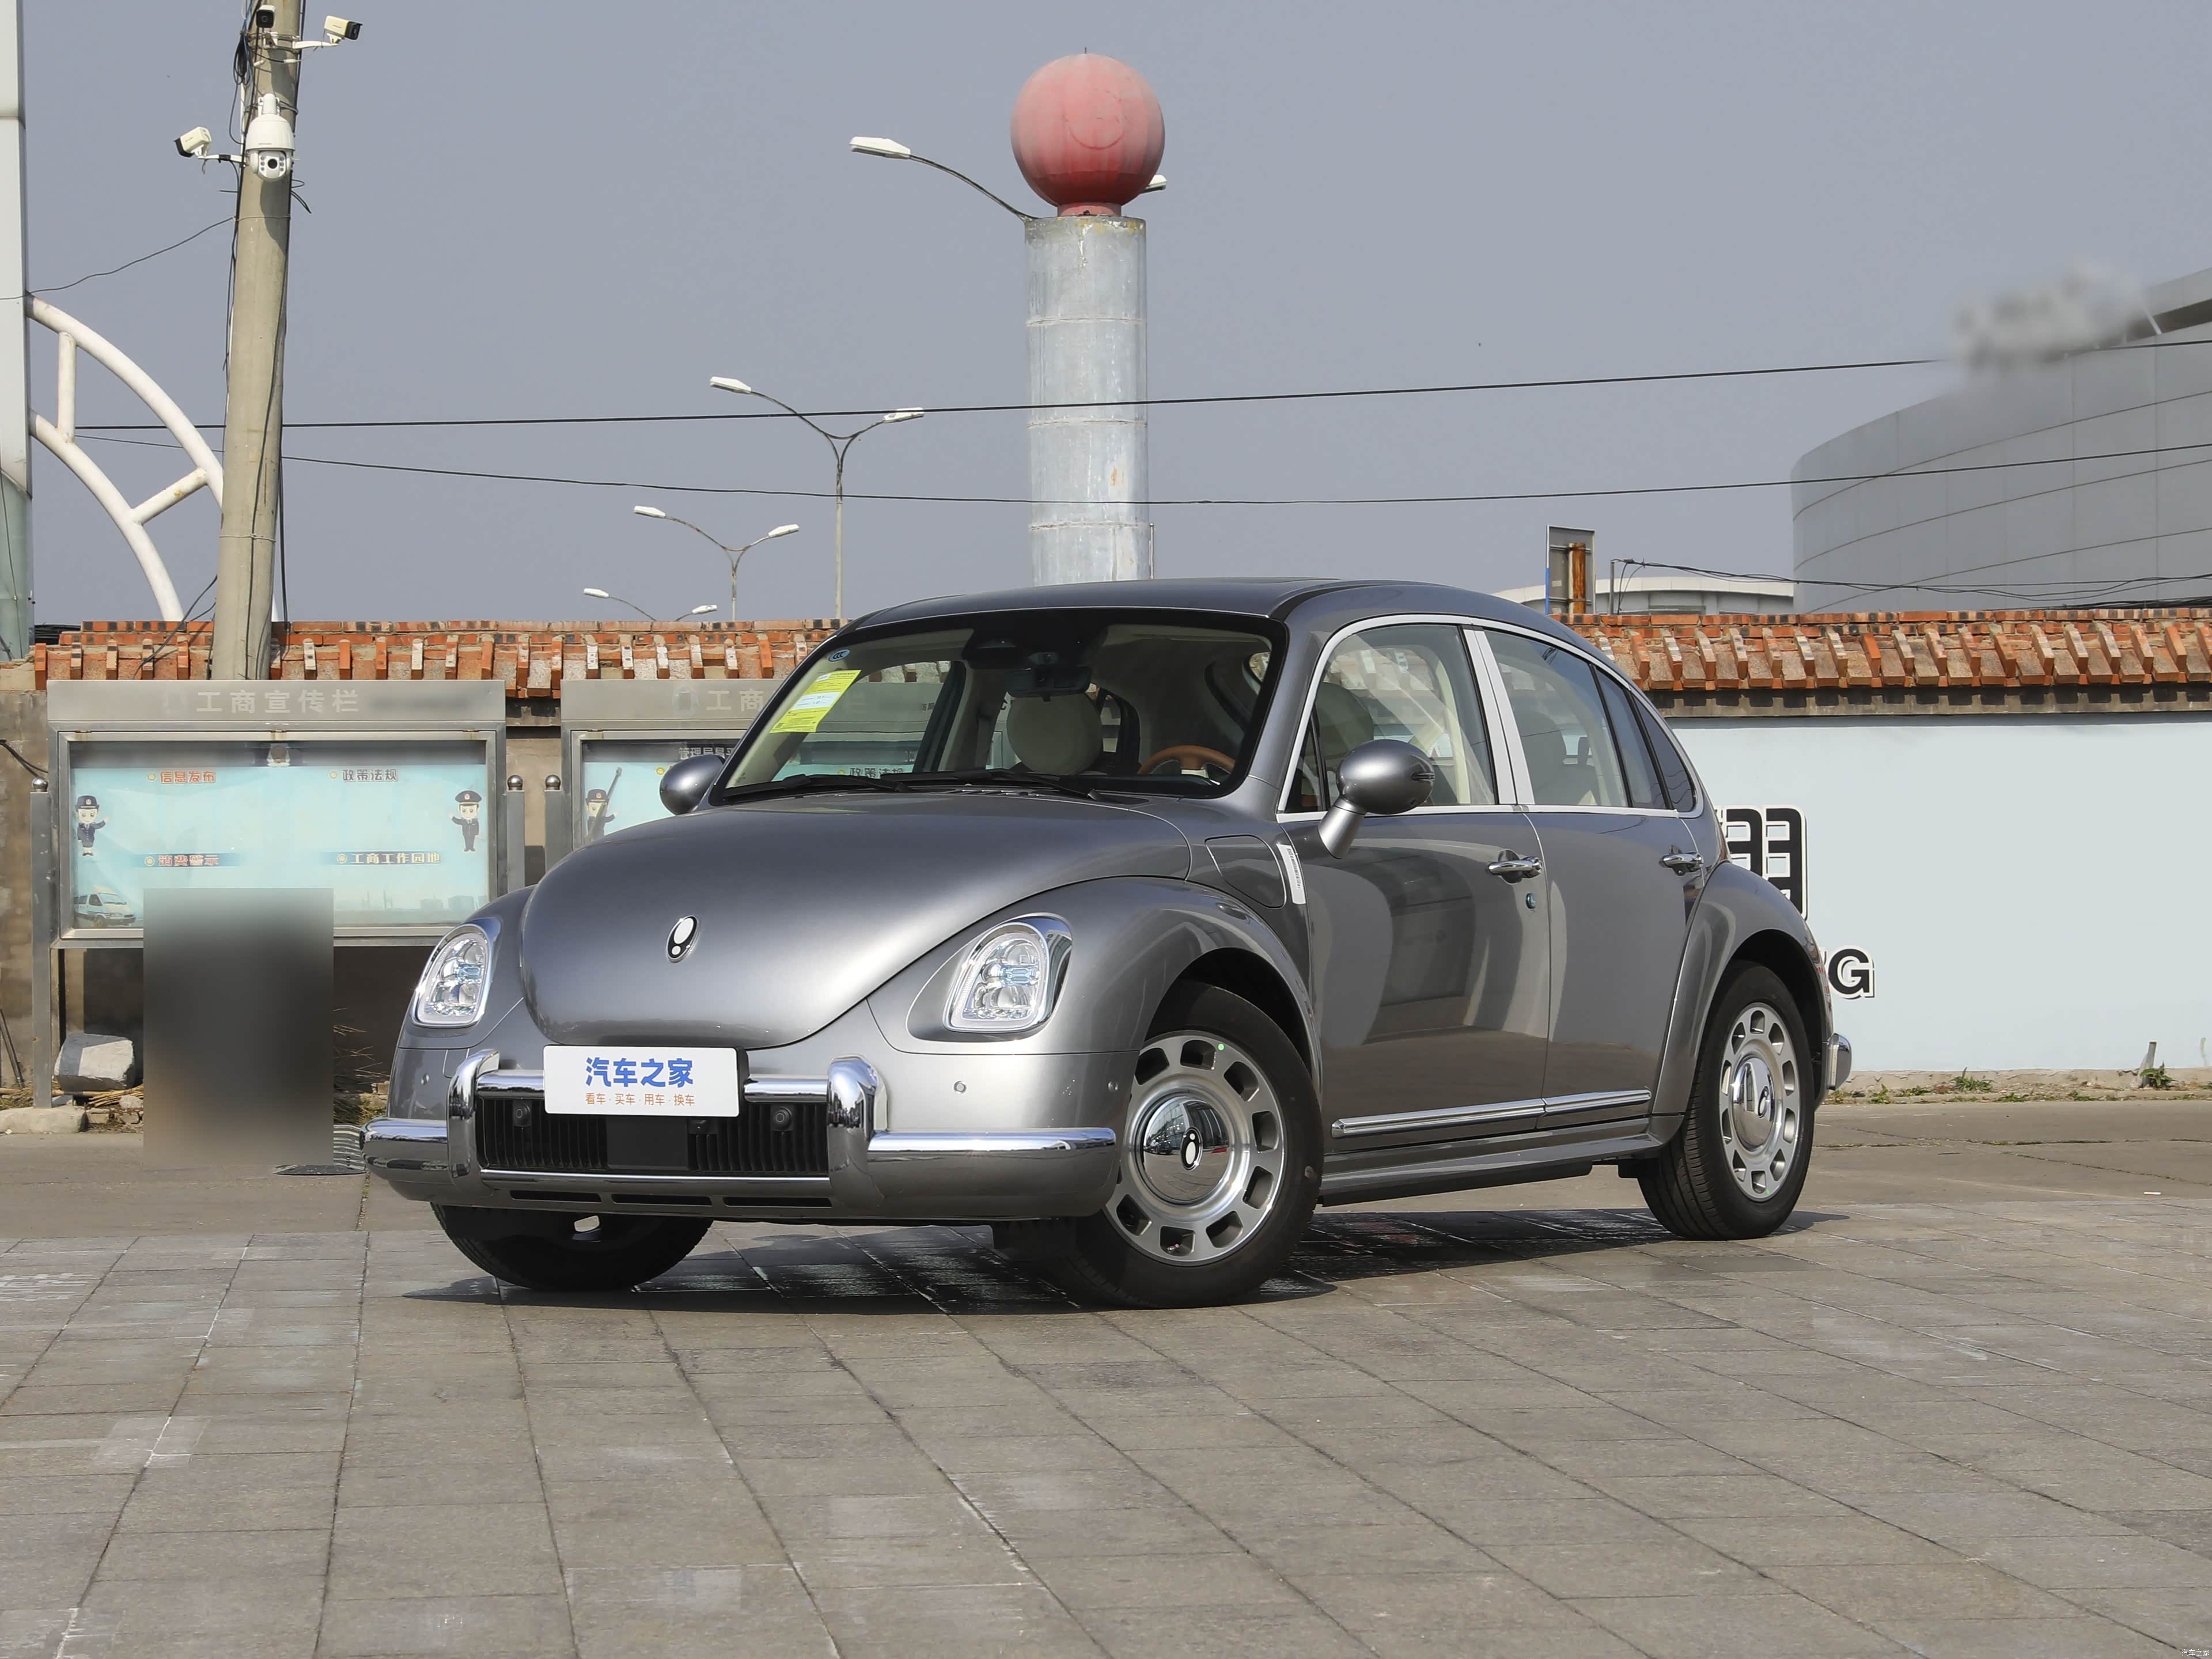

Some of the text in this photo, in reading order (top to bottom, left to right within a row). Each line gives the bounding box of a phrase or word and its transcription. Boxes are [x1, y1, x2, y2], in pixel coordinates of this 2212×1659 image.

[196, 689, 359, 714] 工商宣传栏
[160, 771, 216, 783] 信息发布
[342, 769, 397, 781] 政策法规
[350, 853, 441, 863] 工商工作园地
[585, 1057, 694, 1088] 汽车之家
